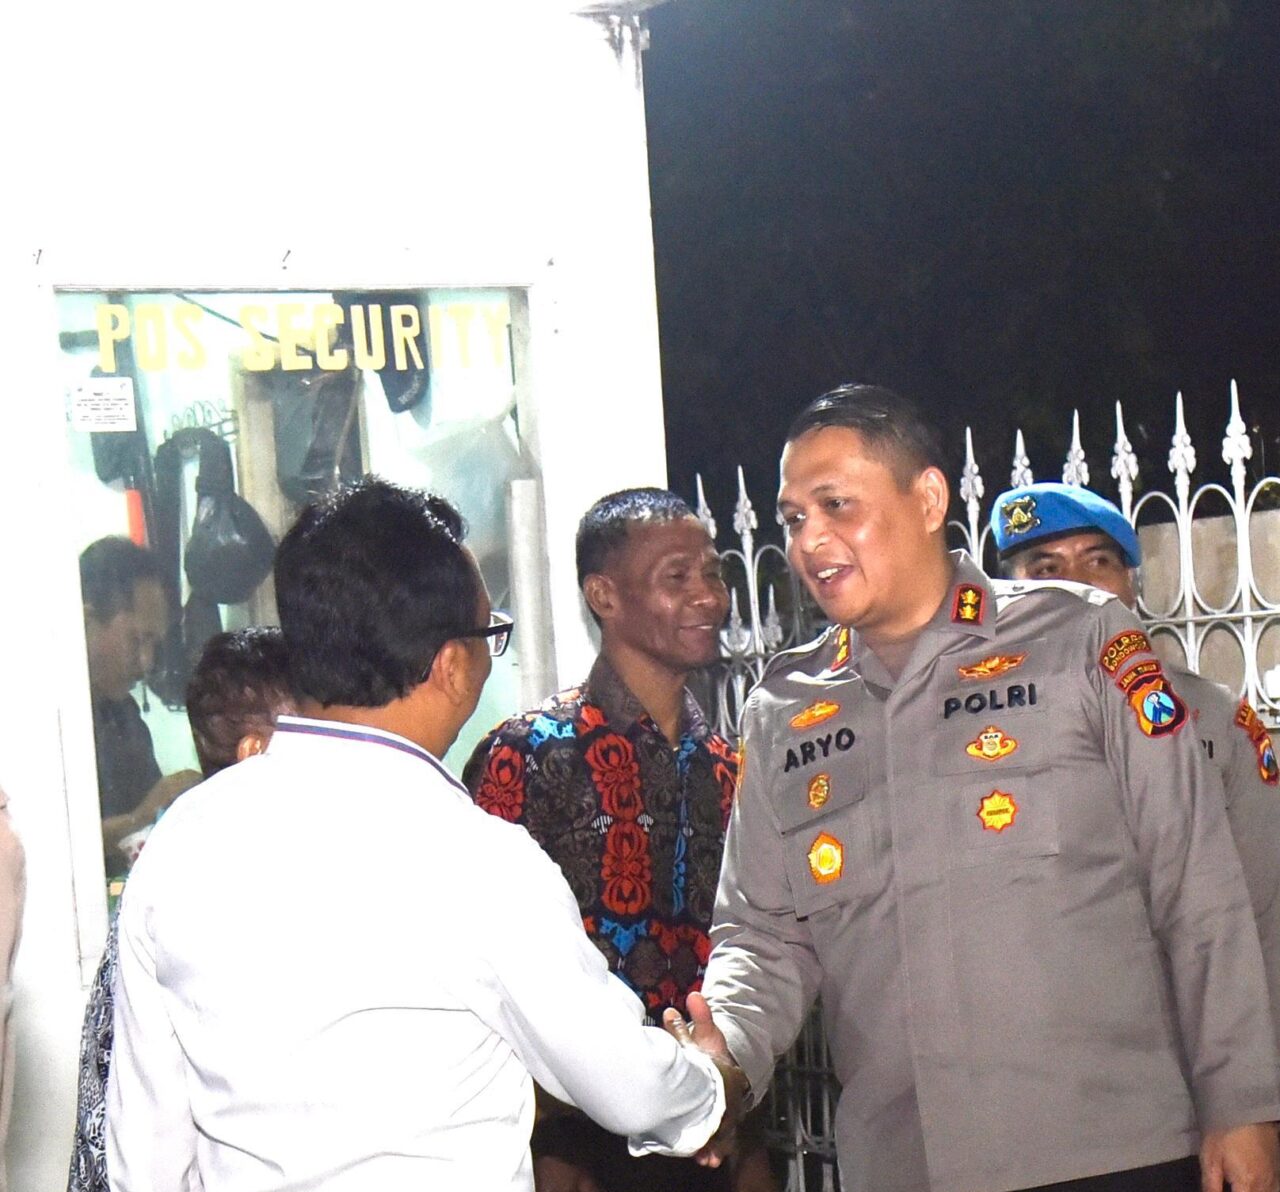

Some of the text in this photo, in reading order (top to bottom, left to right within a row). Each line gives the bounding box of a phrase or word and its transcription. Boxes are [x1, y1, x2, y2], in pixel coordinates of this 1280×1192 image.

[95, 302, 513, 374] POS SECURITY
[943, 683, 1036, 719] POLRI
[783, 727, 856, 773] ARYO
